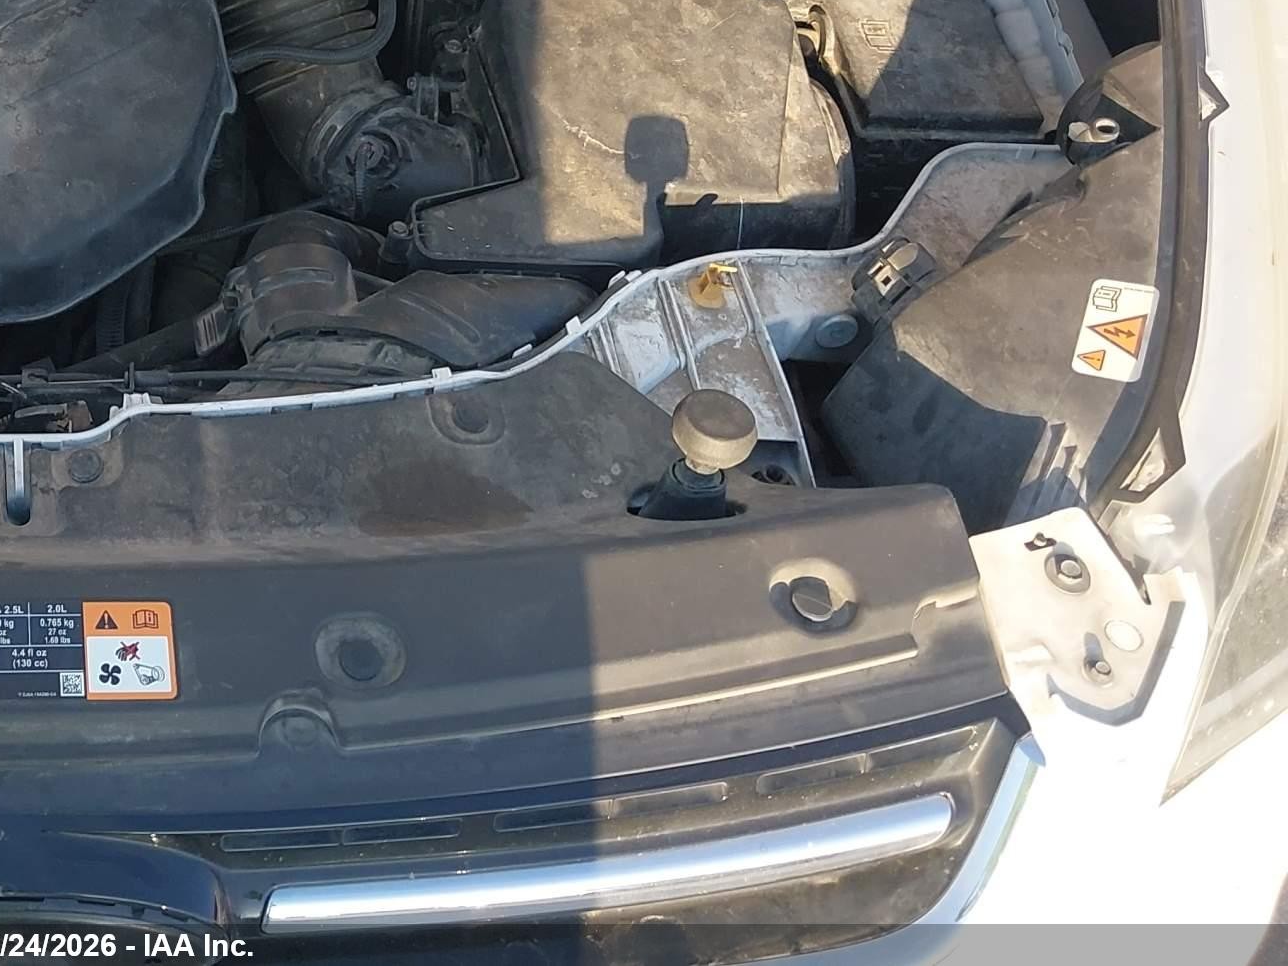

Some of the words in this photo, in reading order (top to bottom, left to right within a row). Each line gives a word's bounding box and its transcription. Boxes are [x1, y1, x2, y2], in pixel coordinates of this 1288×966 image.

[4, 606, 24, 614] 2.5L
[47, 605, 67, 613] 2.0L
[4, 619, 14, 629] kg
[40, 618, 62, 627] 0.765
[64, 618, 74, 628] kg
[13, 659, 32, 668] (130
[34, 659, 48, 668] cc)
